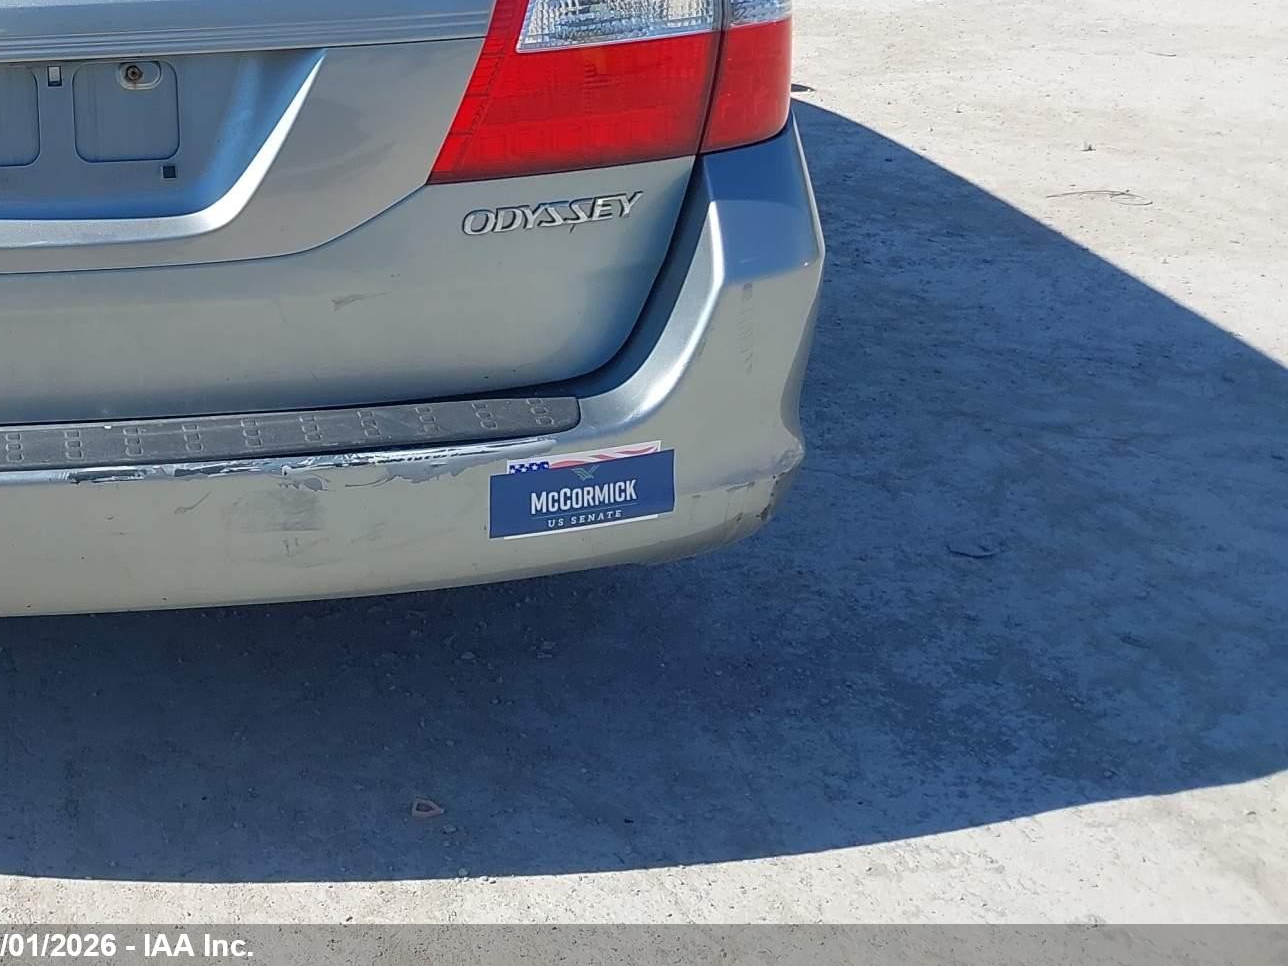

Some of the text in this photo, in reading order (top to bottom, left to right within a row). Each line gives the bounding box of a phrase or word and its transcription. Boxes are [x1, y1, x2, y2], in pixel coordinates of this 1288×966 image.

[463, 190, 644, 235] ODYSSEY
[547, 509, 623, 528] US SENATE
